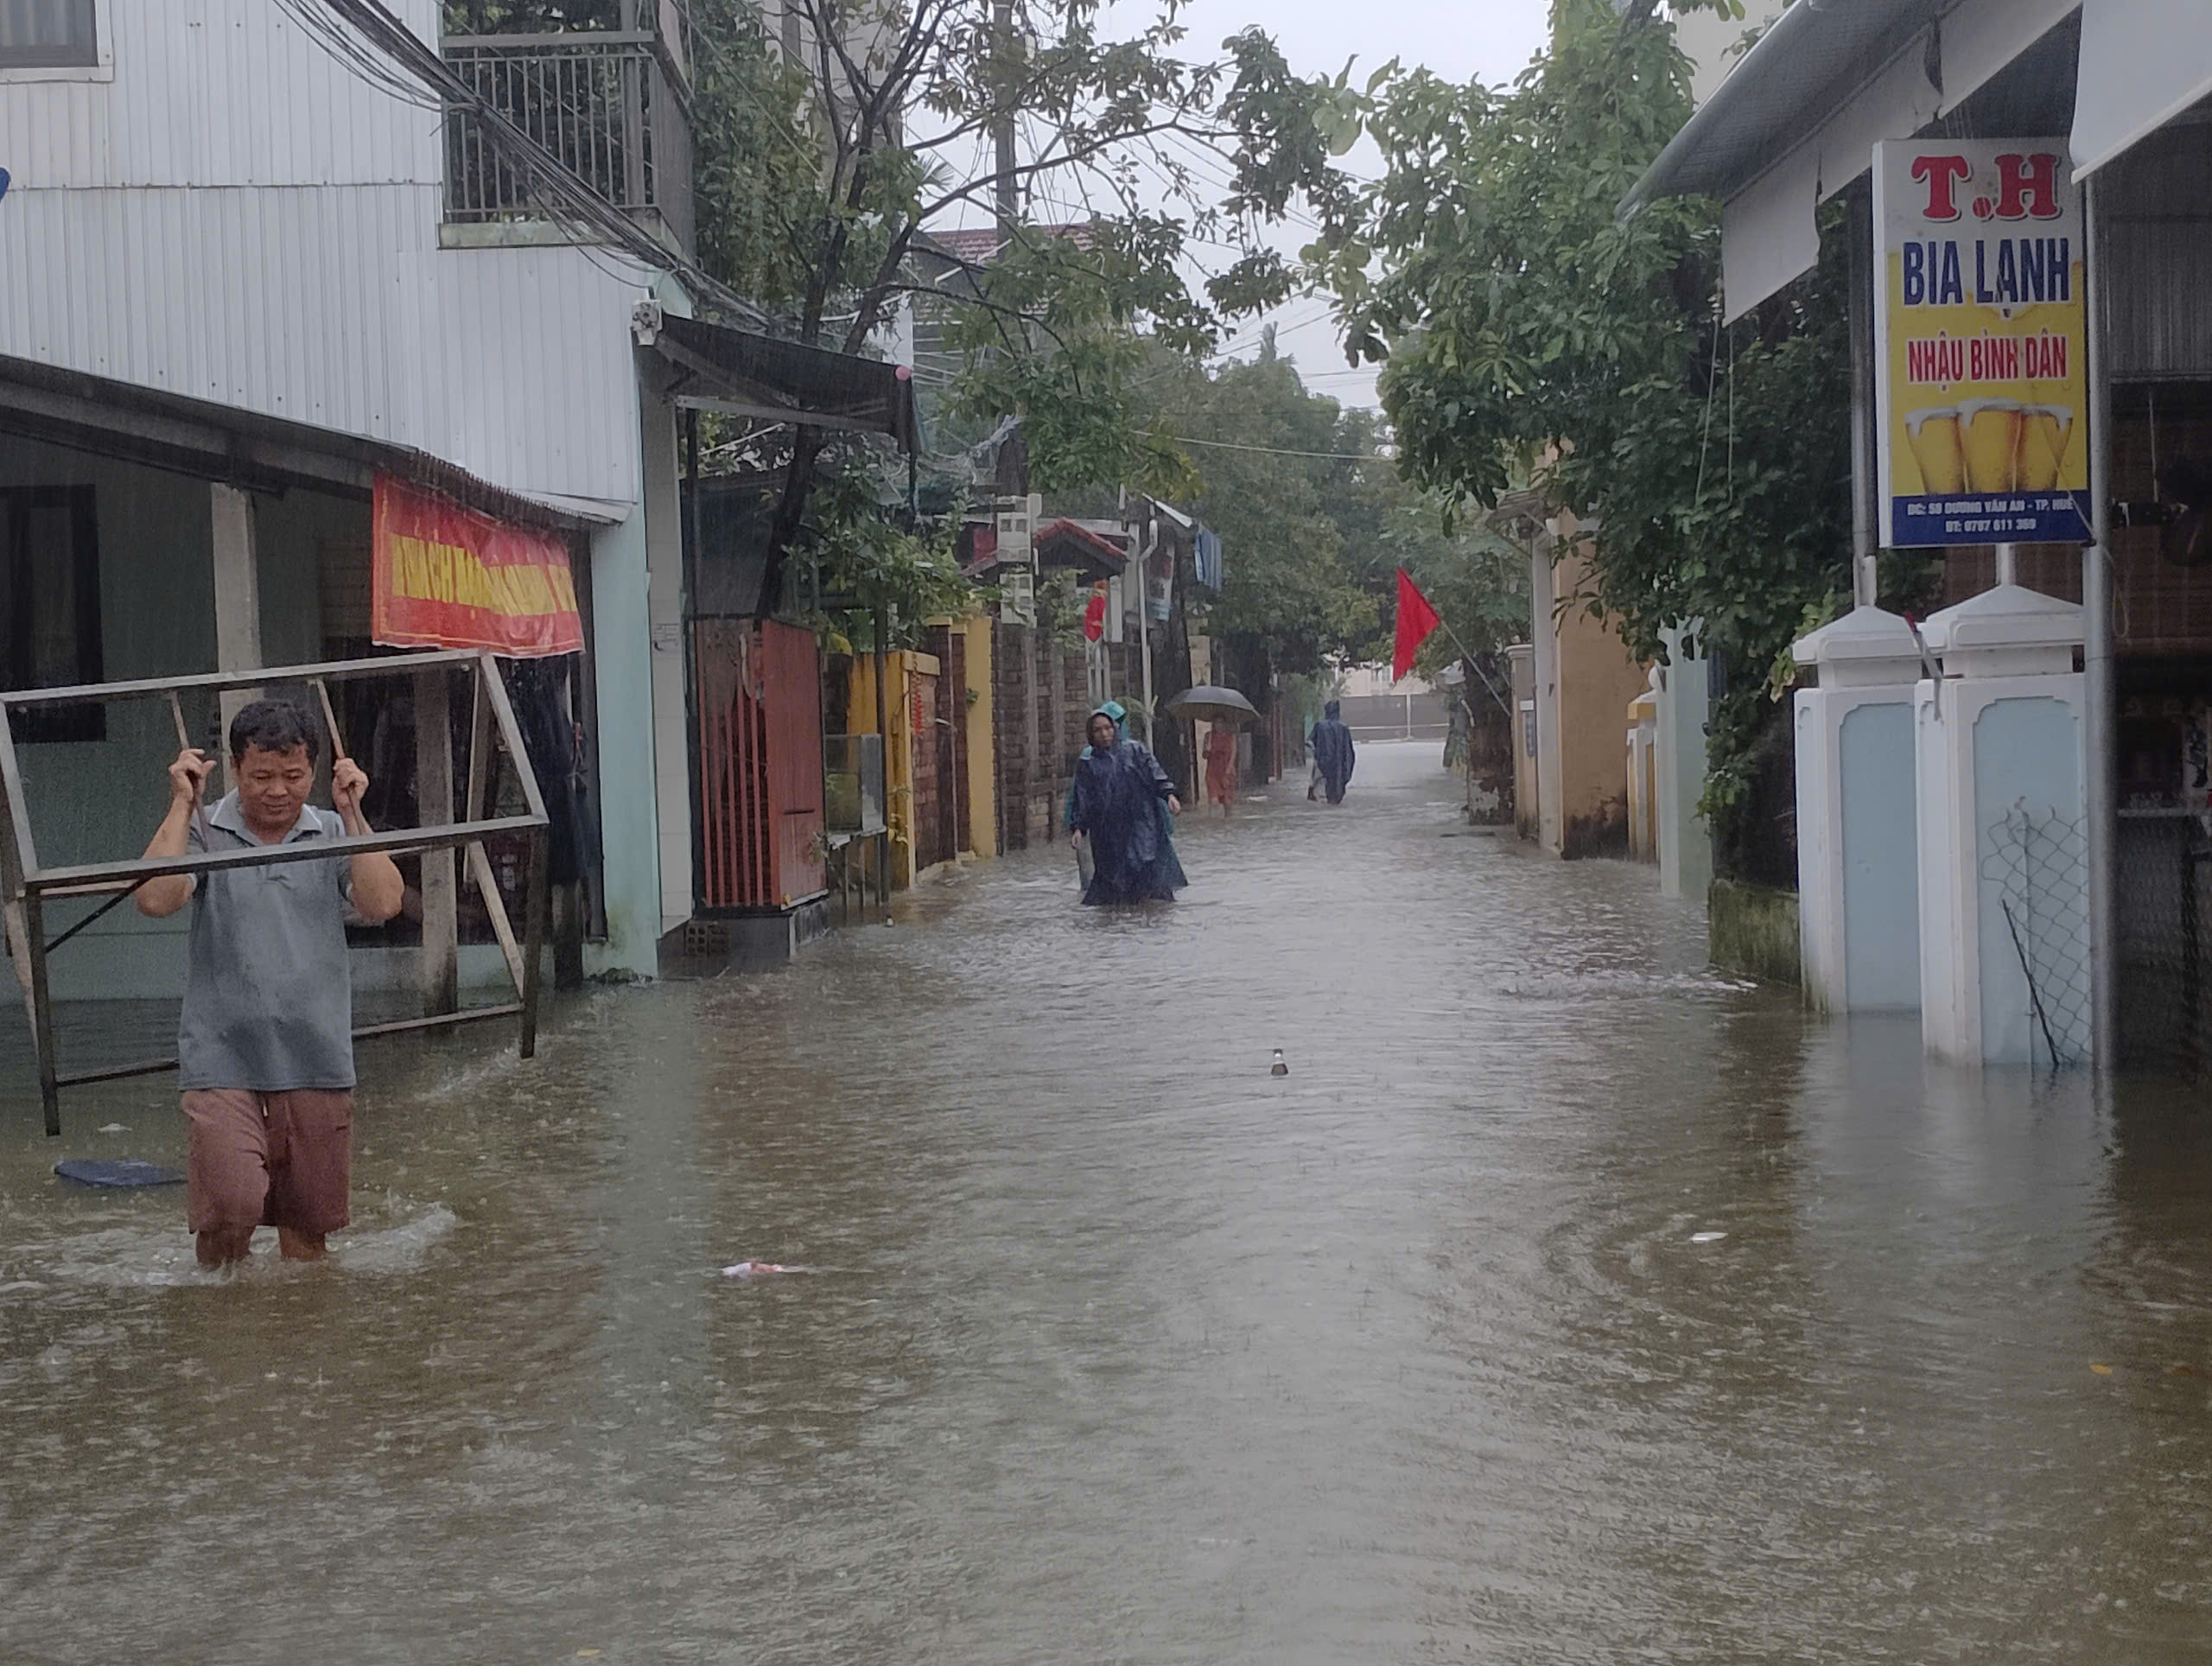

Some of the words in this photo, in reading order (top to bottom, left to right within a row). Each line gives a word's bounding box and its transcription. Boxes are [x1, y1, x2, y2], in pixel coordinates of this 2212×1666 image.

[1910, 153, 2062, 220] T.H
[1903, 240, 1963, 305] BIA
[1975, 238, 2069, 318] LẠNH
[1908, 331, 1963, 391] NHẬU
[1970, 329, 2018, 380] BÌNH
[2025, 327, 2067, 378] DÂN
